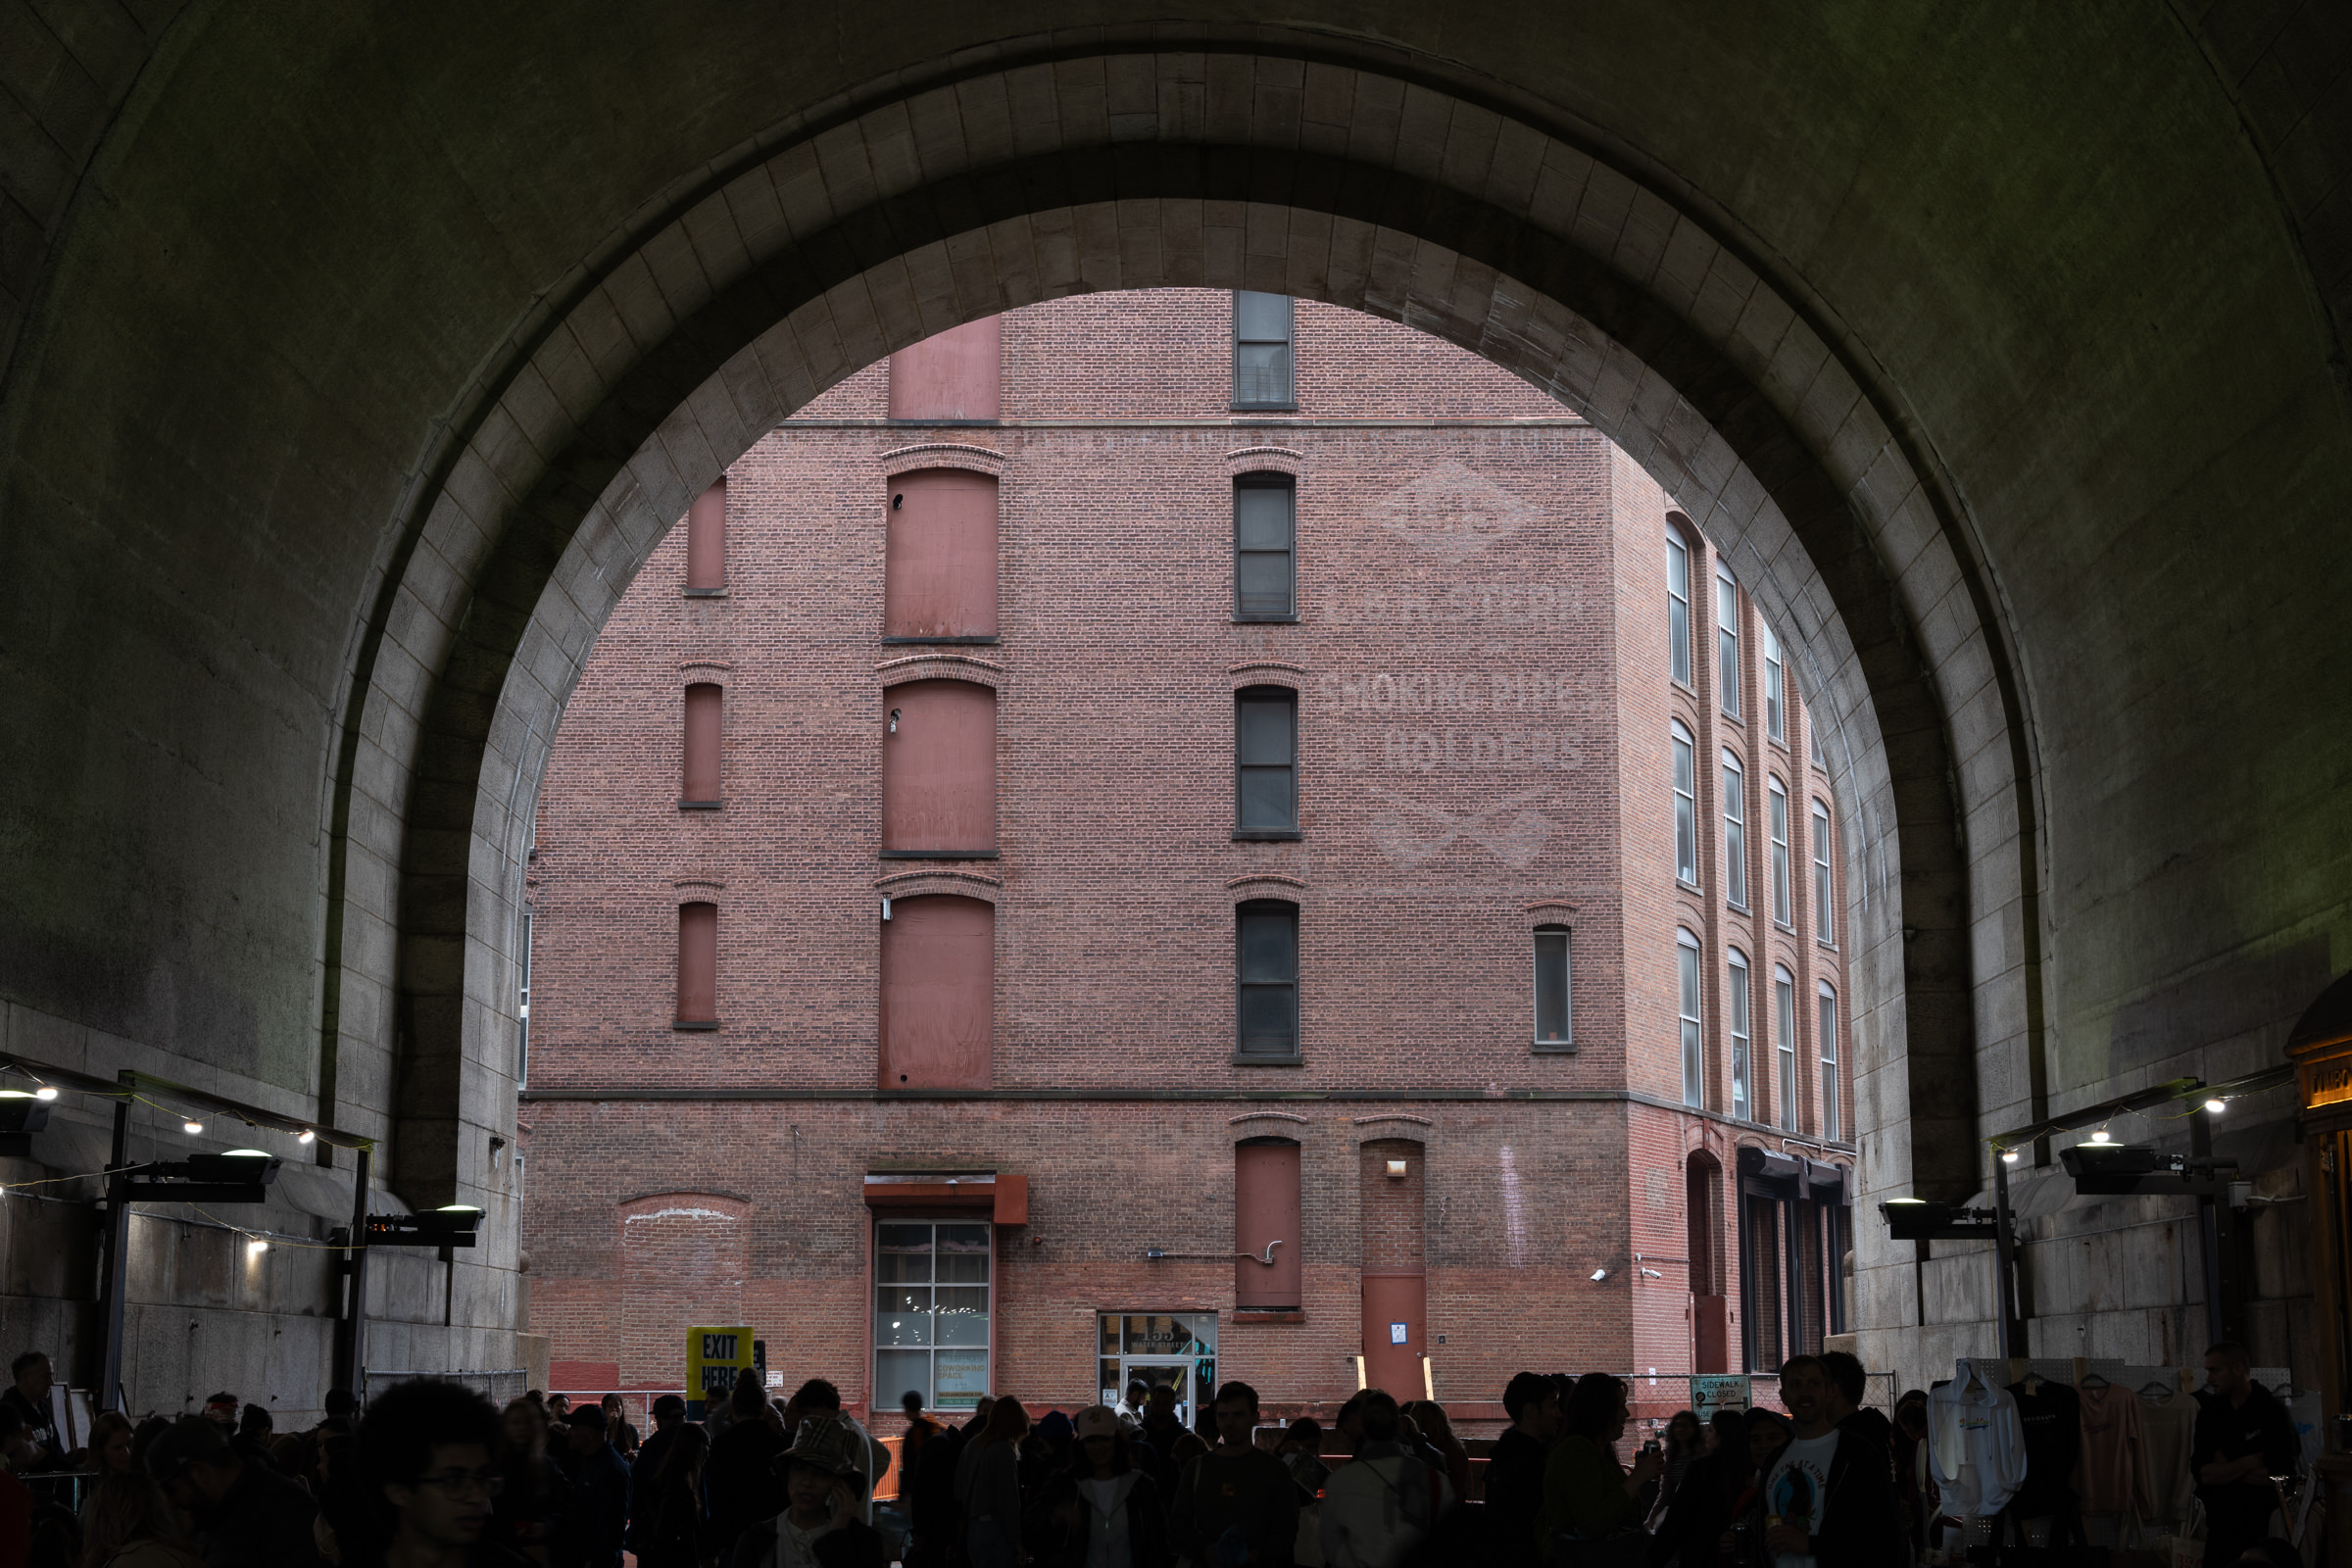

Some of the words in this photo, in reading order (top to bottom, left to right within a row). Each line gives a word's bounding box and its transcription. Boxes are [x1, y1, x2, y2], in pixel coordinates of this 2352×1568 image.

[1318, 671, 1481, 713] SMOKING
[1491, 671, 1601, 713] PIPES
[1383, 730, 1585, 772] HOLDERS
[1142, 1326, 1174, 1342] 155
[702, 1334, 738, 1360] EXIT
[701, 1365, 738, 1392] HERE
[1701, 1380, 1740, 1389] SIDEWALK
[1706, 1390, 1737, 1398] CLOSED
[1813, 1468, 1828, 1490] TIME
